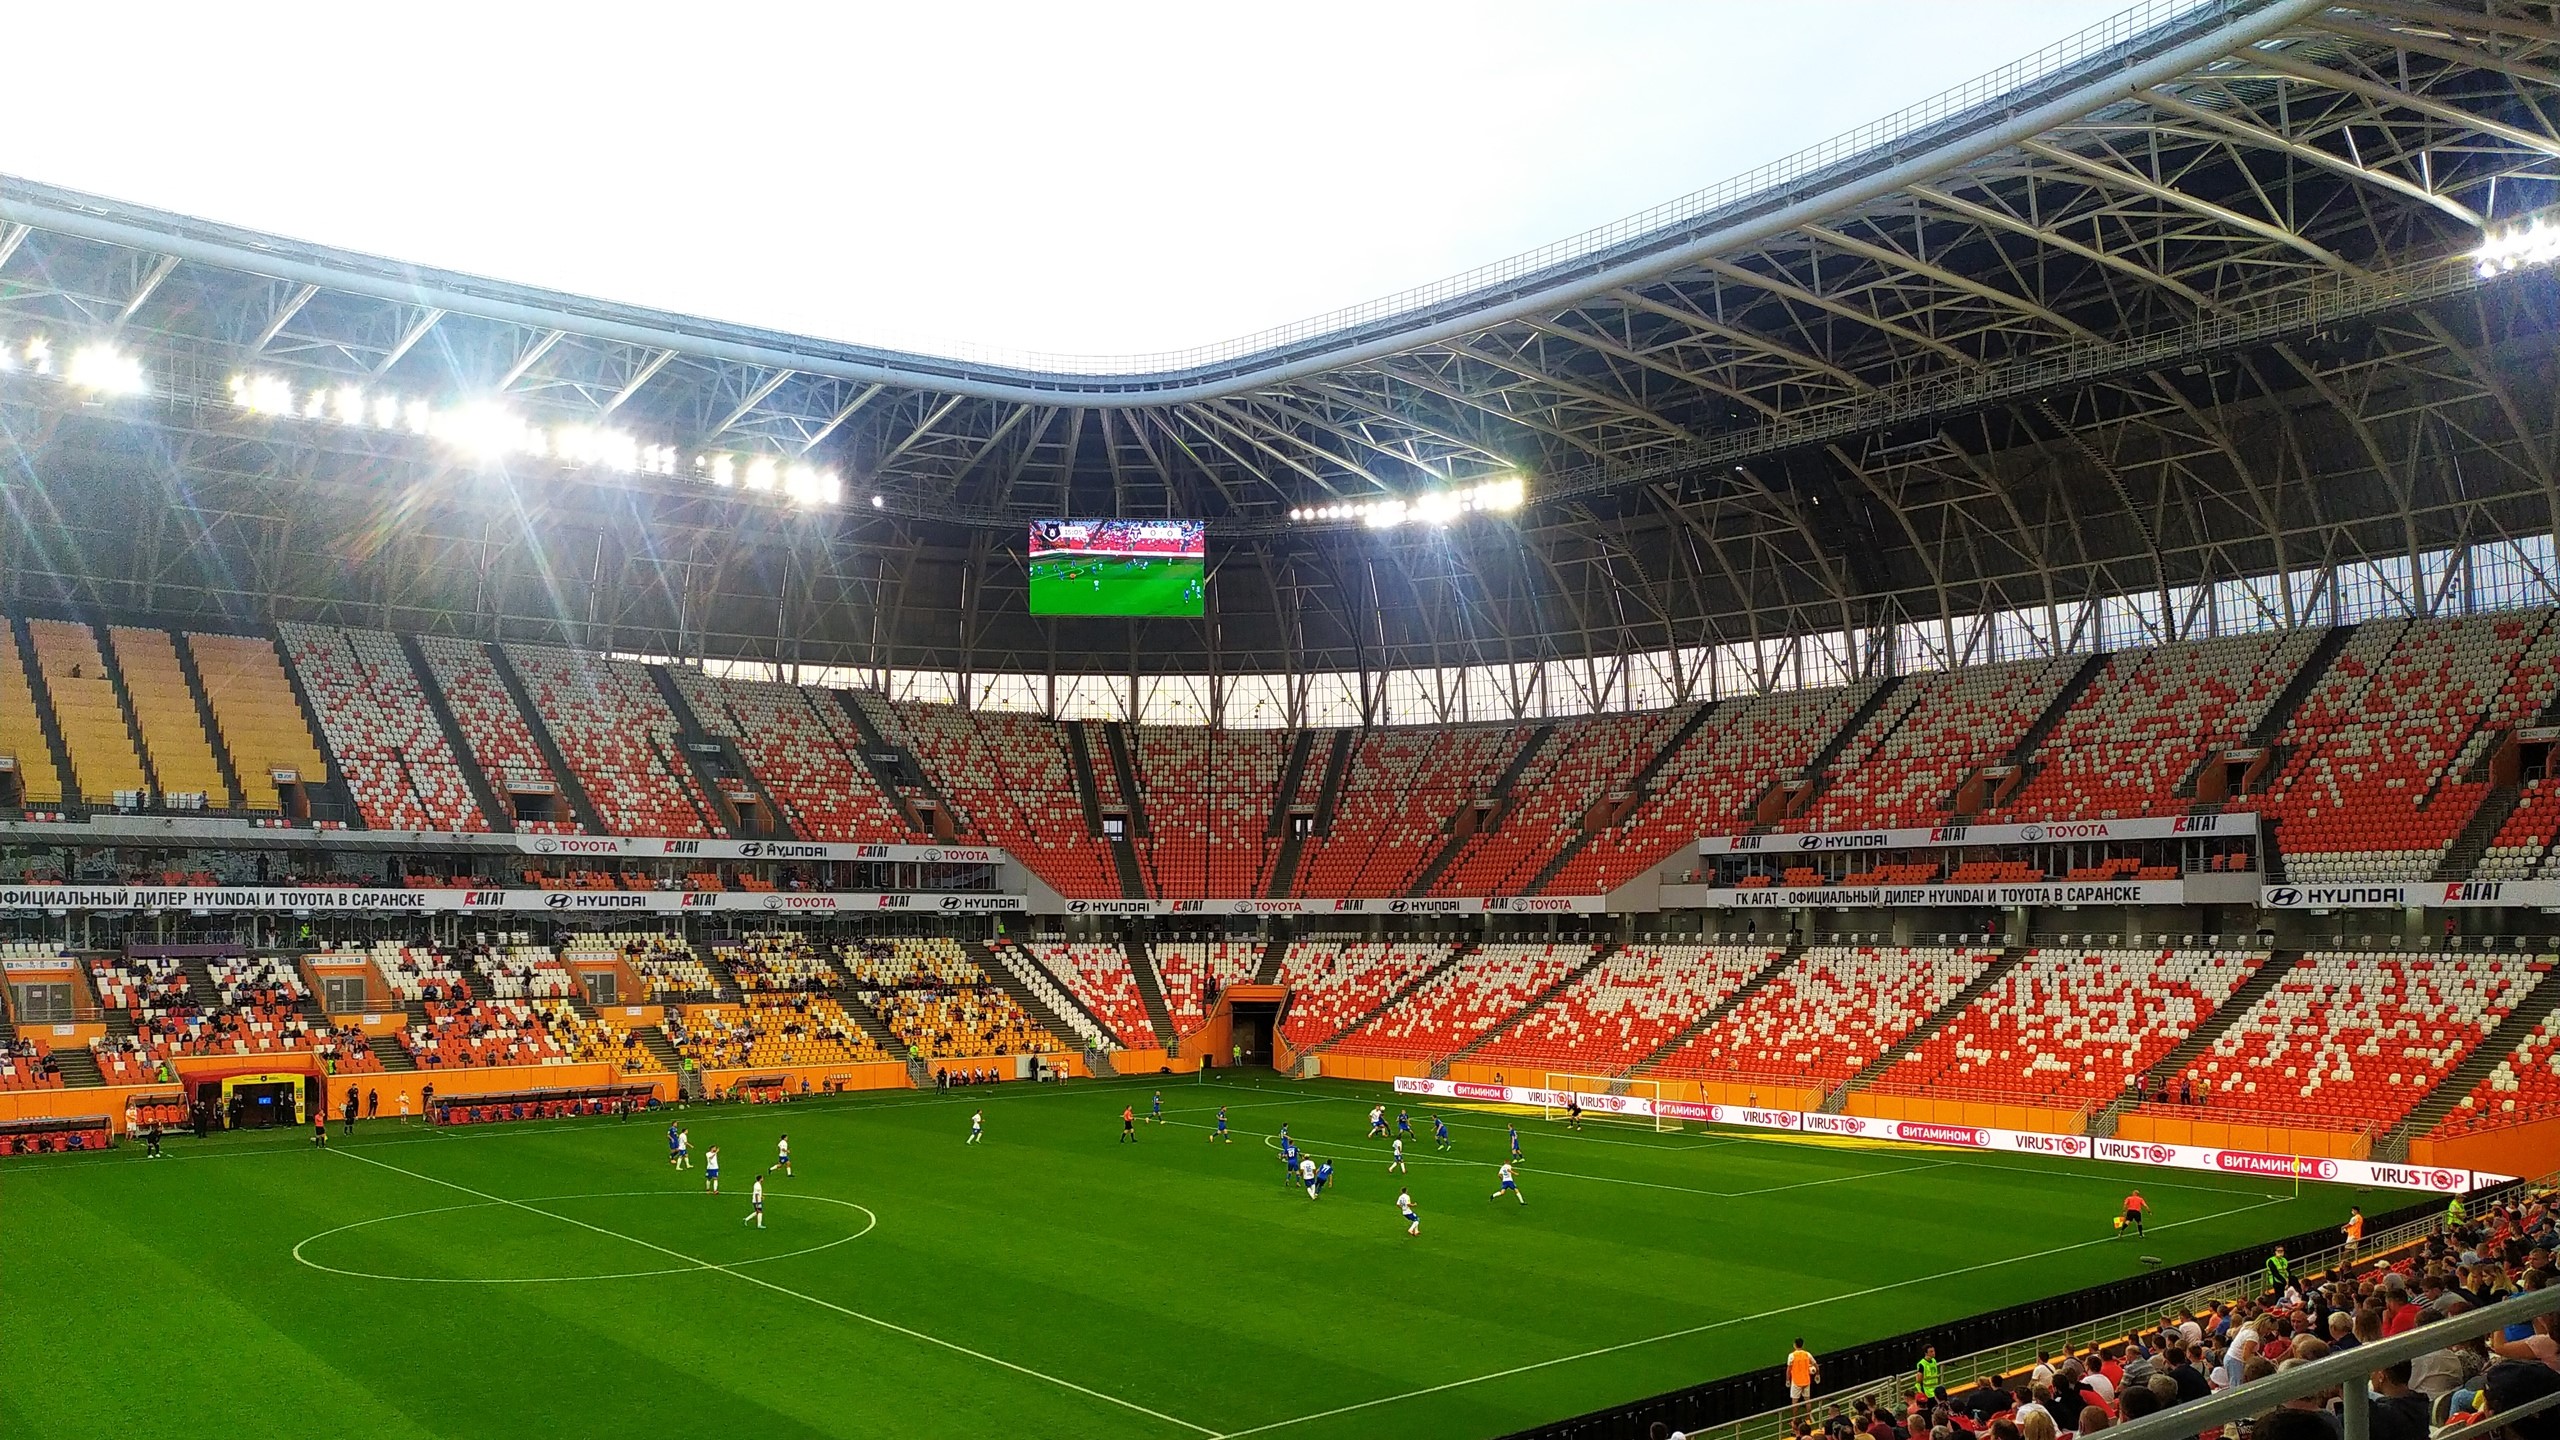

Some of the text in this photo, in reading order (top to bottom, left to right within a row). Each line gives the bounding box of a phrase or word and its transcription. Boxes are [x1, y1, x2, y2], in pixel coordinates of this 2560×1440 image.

[2046, 824, 2109, 838] TOYOTA
[560, 841, 618, 852] TOYOTA
[1825, 835, 1888, 848] HYUNDAI
[767, 846, 827, 857] HYUNDAI
[943, 850, 989, 861] TOYOTA
[0, 889, 425, 907] ФИЦИАЛЬНЫЙ ДИЛЕР HYUNDAI И TOYOTA В САРАНСКЕ
[1736, 893, 1749, 905] ГК
[1751, 892, 1779, 905] АГАТ
[1789, 887, 1880, 905] ОФИЦИАЛЬНЫЙ
[1884, 891, 1925, 906] ДИЛЕР
[1929, 890, 1983, 903] HYUNDAI
[1988, 889, 1996, 902] И
[2001, 888, 2050, 902] TOYOTA
[2055, 888, 2063, 900] В
[2067, 887, 2141, 901] САРАНСКЕ
[2308, 888, 2404, 903] HYUNDAI
[577, 896, 646, 907] HYUNDAI
[785, 897, 836, 908] TOYOTA
[964, 898, 1019, 909] HYUNDAI
[1092, 902, 1150, 912] HYUNDAI
[1254, 902, 1302, 912] TOYOTA
[1411, 901, 1459, 911] HYUNDAI
[1529, 900, 1572, 910] TOYOTA
[1457, 1086, 1501, 1098] ВИТАМИНОМ
[1902, 1125, 1971, 1142] ВИТАМИНОМ
